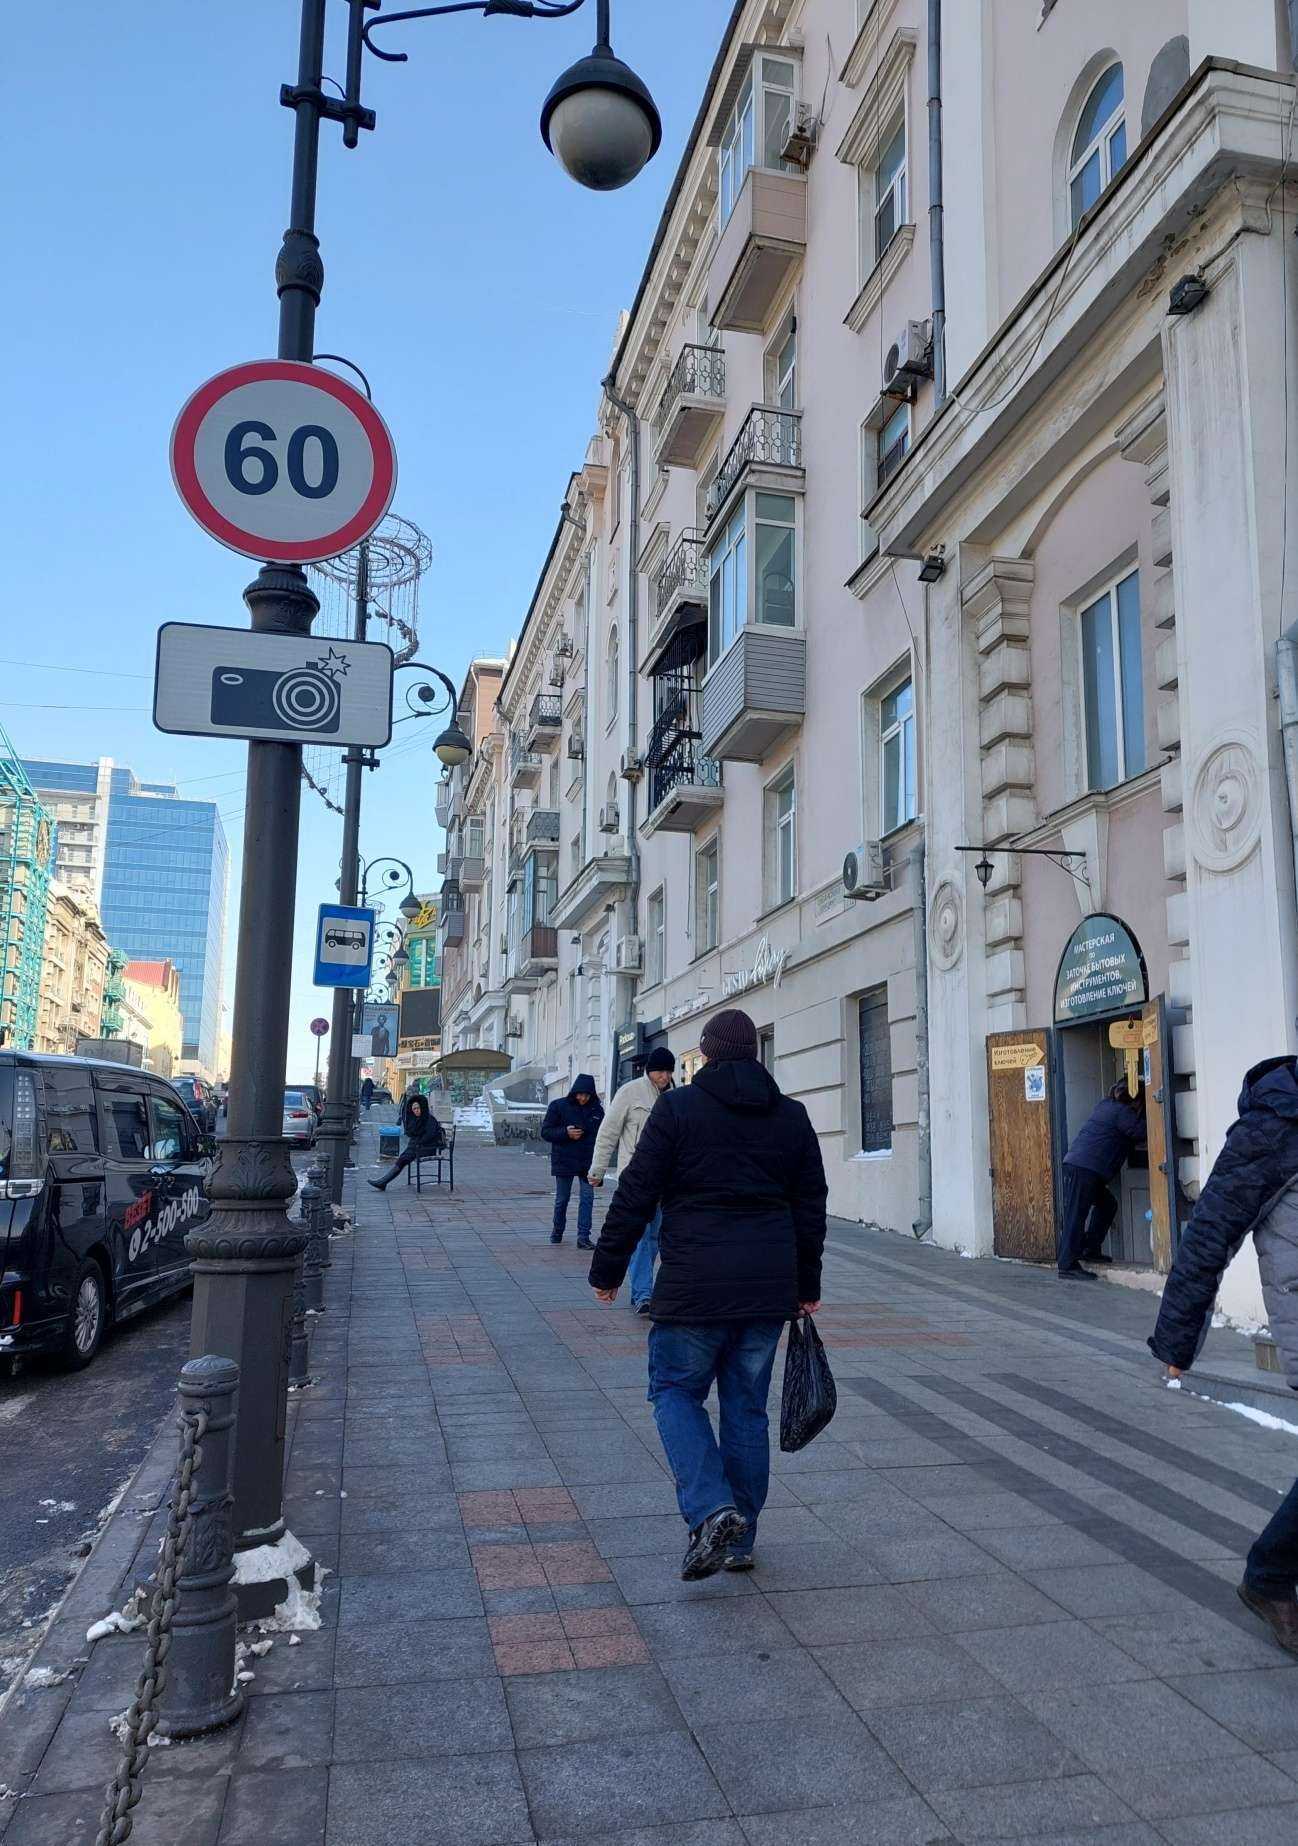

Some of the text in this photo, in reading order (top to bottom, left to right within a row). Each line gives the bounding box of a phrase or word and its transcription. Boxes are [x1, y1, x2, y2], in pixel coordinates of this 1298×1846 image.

[225, 420, 339, 499] 60
[1074, 933, 1115, 954] МАСТЕРСКАЯ
[1066, 953, 1126, 980] ЗАТОЧКЕ БЫТОВЫХ
[1060, 979, 1137, 1009] ИЗГОТОВЛЕНИЕ КЛЮЧЕЙ
